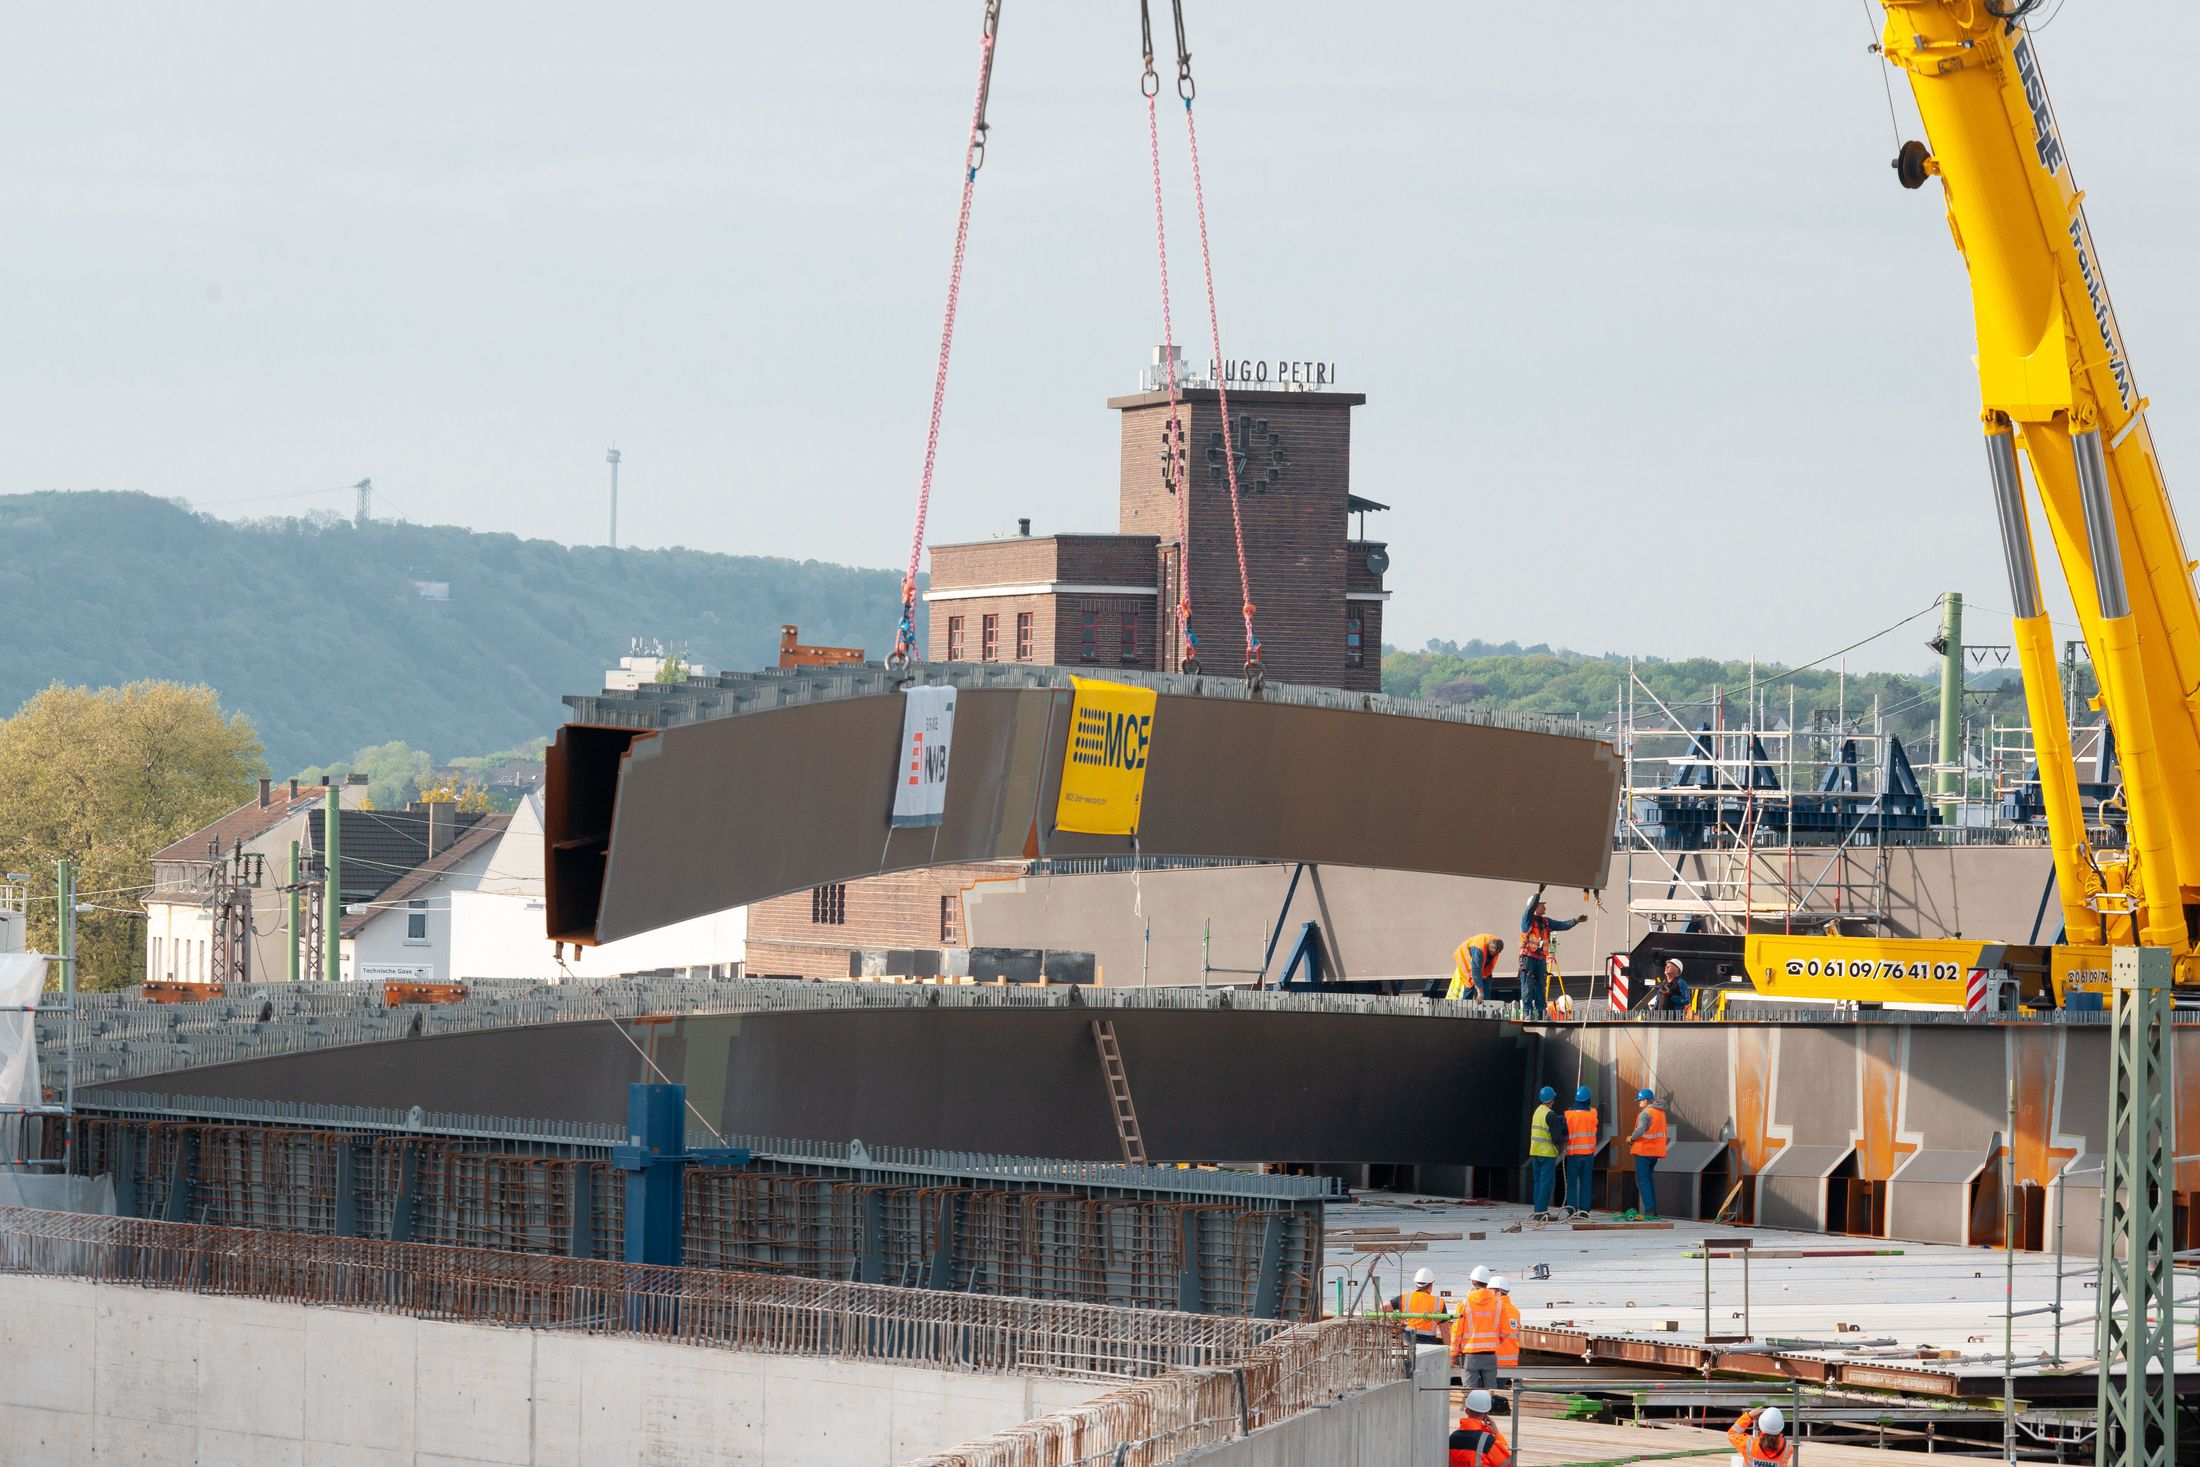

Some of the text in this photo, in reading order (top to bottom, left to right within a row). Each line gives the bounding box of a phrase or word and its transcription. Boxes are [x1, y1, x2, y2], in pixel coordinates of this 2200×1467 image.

[2013, 36, 2063, 176] EISELE
[1210, 359, 1335, 384] HUGO PETRI
[1103, 712, 1151, 770] MCE
[1807, 961, 1957, 980] 0 61 09/76 41 02
